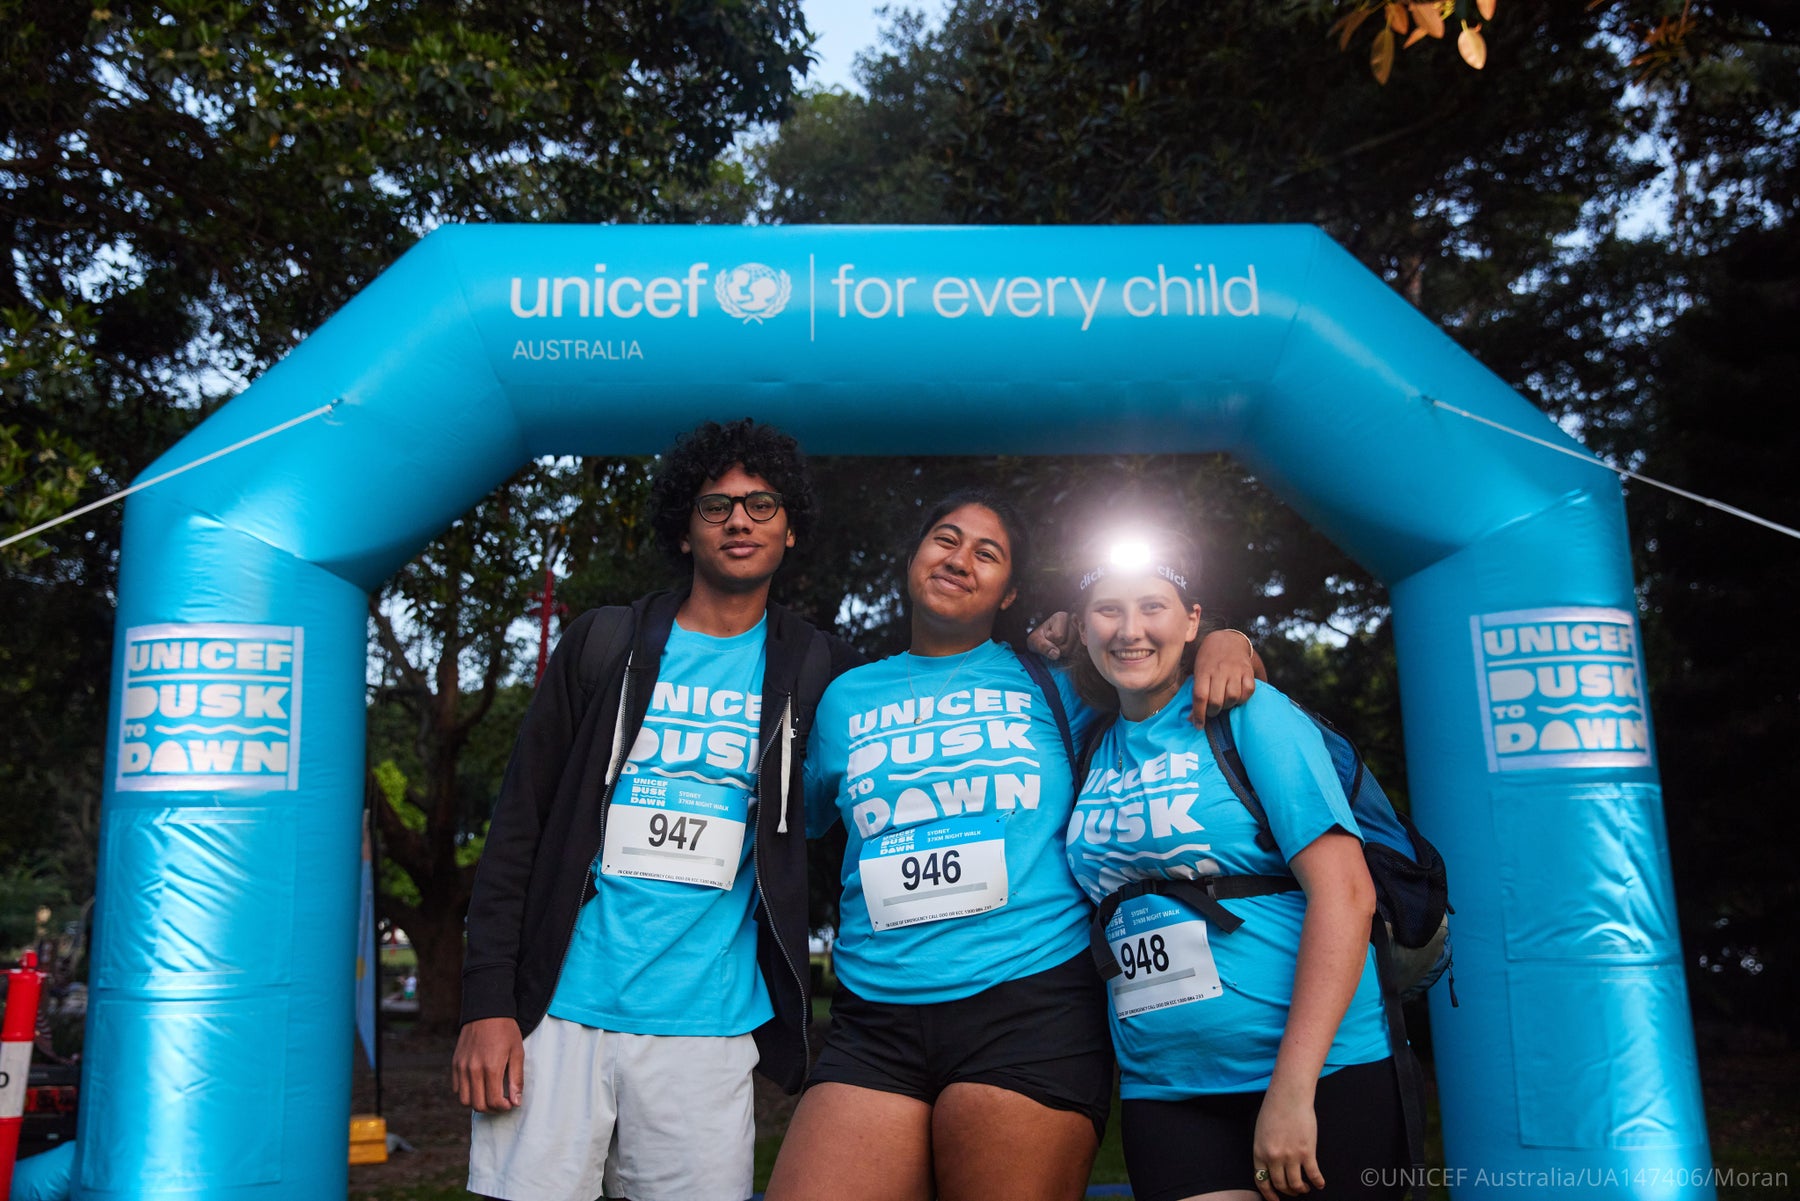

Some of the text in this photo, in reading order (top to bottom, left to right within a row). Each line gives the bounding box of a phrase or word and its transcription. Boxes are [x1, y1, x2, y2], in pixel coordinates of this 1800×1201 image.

[510, 262, 709, 318] unicef
[831, 263, 1261, 331] for every child
[512, 339, 643, 361] AUSTRALIA
[1080, 566, 1105, 591] click
[1158, 565, 1188, 591] click
[1483, 624, 1633, 656] UNICEF
[129, 641, 292, 671] UNICEF
[1489, 664, 1639, 702] DUSK
[127, 683, 289, 719] DUSK
[652, 682, 762, 720] NICE
[848, 687, 1031, 738] UNICEF
[1493, 704, 1525, 719] TO
[123, 723, 147, 738] TO
[1494, 718, 1645, 753] DAWN
[123, 739, 288, 773] DAWN
[847, 720, 1036, 783] DUSK
[631, 786, 667, 797] DUSK
[633, 777, 668, 787] UNICEF
[679, 790, 702, 799] SYDNEY
[847, 777, 875, 800] TO
[630, 796, 666, 807] DAWN
[695, 800, 713, 809] NIGHT
[713, 804, 729, 812] WALK
[853, 773, 1041, 839] DAWN
[648, 813, 708, 851] 947
[927, 828, 950, 837] SYDNEY
[945, 832, 963, 840] NIGHT
[964, 830, 982, 838] WALK
[880, 844, 915, 855] DAWN
[901, 850, 961, 891] 946
[1146, 912, 1162, 922] NIGHT
[1162, 909, 1180, 918] WALK
[1120, 933, 1170, 980] 948
